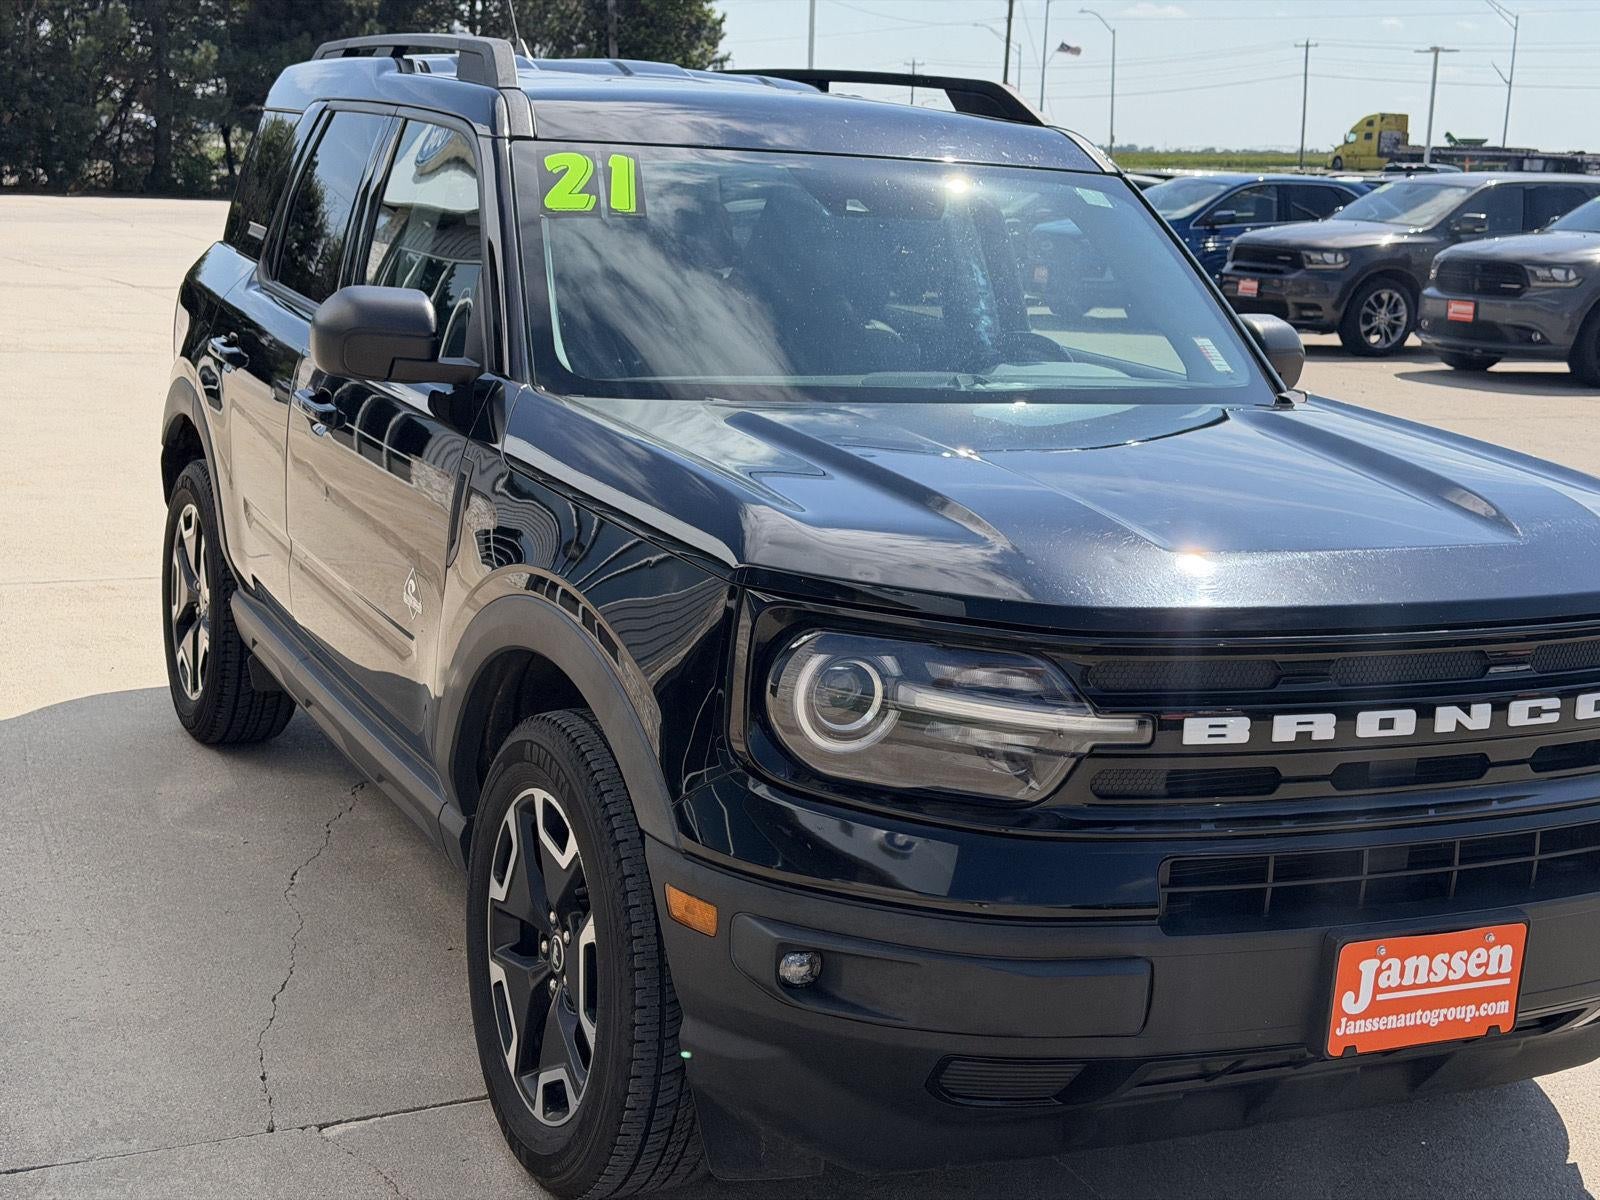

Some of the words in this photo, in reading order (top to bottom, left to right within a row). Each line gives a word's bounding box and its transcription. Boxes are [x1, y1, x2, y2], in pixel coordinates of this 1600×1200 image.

[543, 152, 637, 213] 21
[1341, 943, 1513, 1015] Janssen
[1335, 999, 1510, 1037] Janssenautogroup.com
